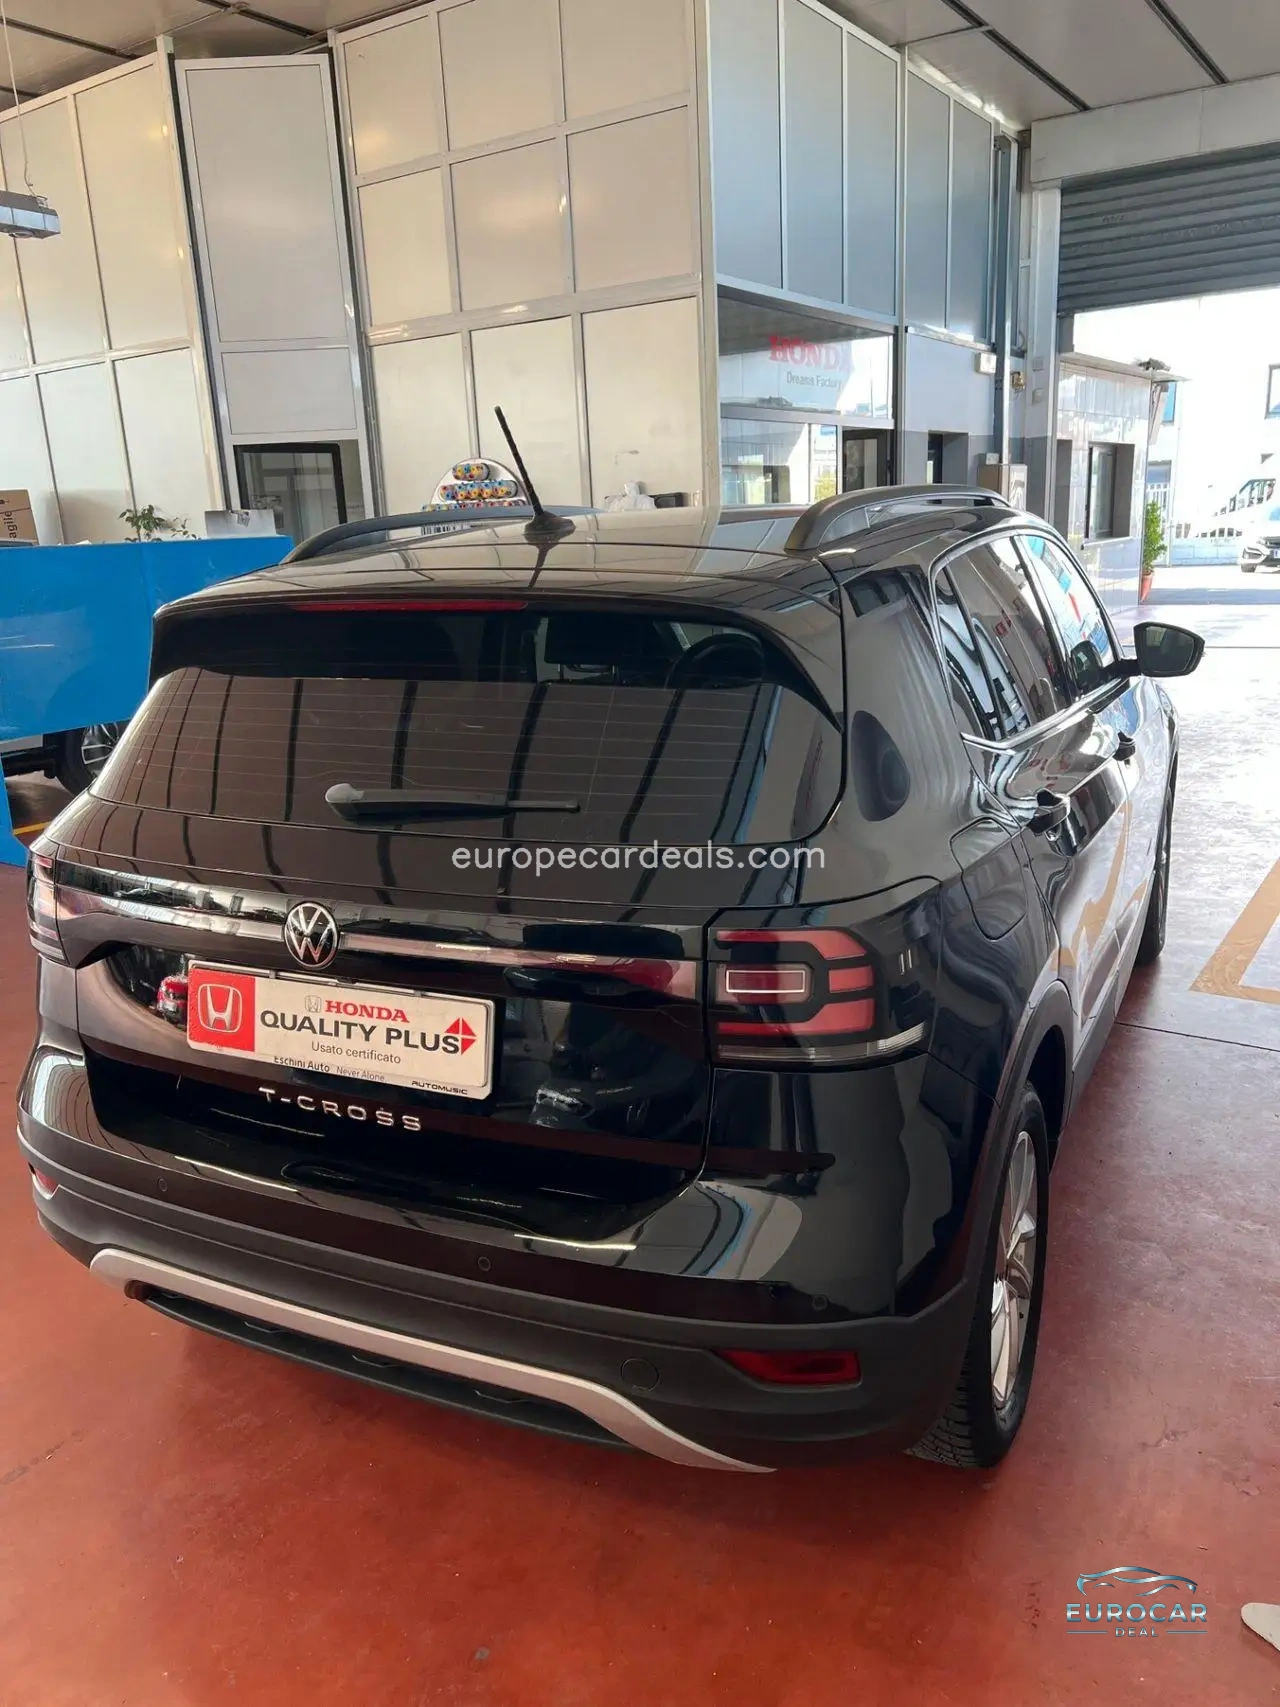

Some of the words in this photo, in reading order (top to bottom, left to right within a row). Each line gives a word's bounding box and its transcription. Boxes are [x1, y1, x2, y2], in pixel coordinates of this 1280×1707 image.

[786, 371, 814, 386] Dreams
[3, 511, 18, 539] agile
[325, 1000, 410, 1023] HONDA
[260, 1010, 377, 1042] QUALITY
[386, 1027, 460, 1055] PLUS
[311, 1041, 343, 1056] Usato
[345, 1048, 401, 1064] certificato
[274, 1055, 306, 1068] Eschini
[308, 1060, 330, 1073] Auto
[336, 1066, 360, 1078] Never
[361, 1069, 385, 1081] Alone
[411, 1080, 468, 1096] AUTOMUSIC
[258, 1086, 422, 1131] T-CROSS
